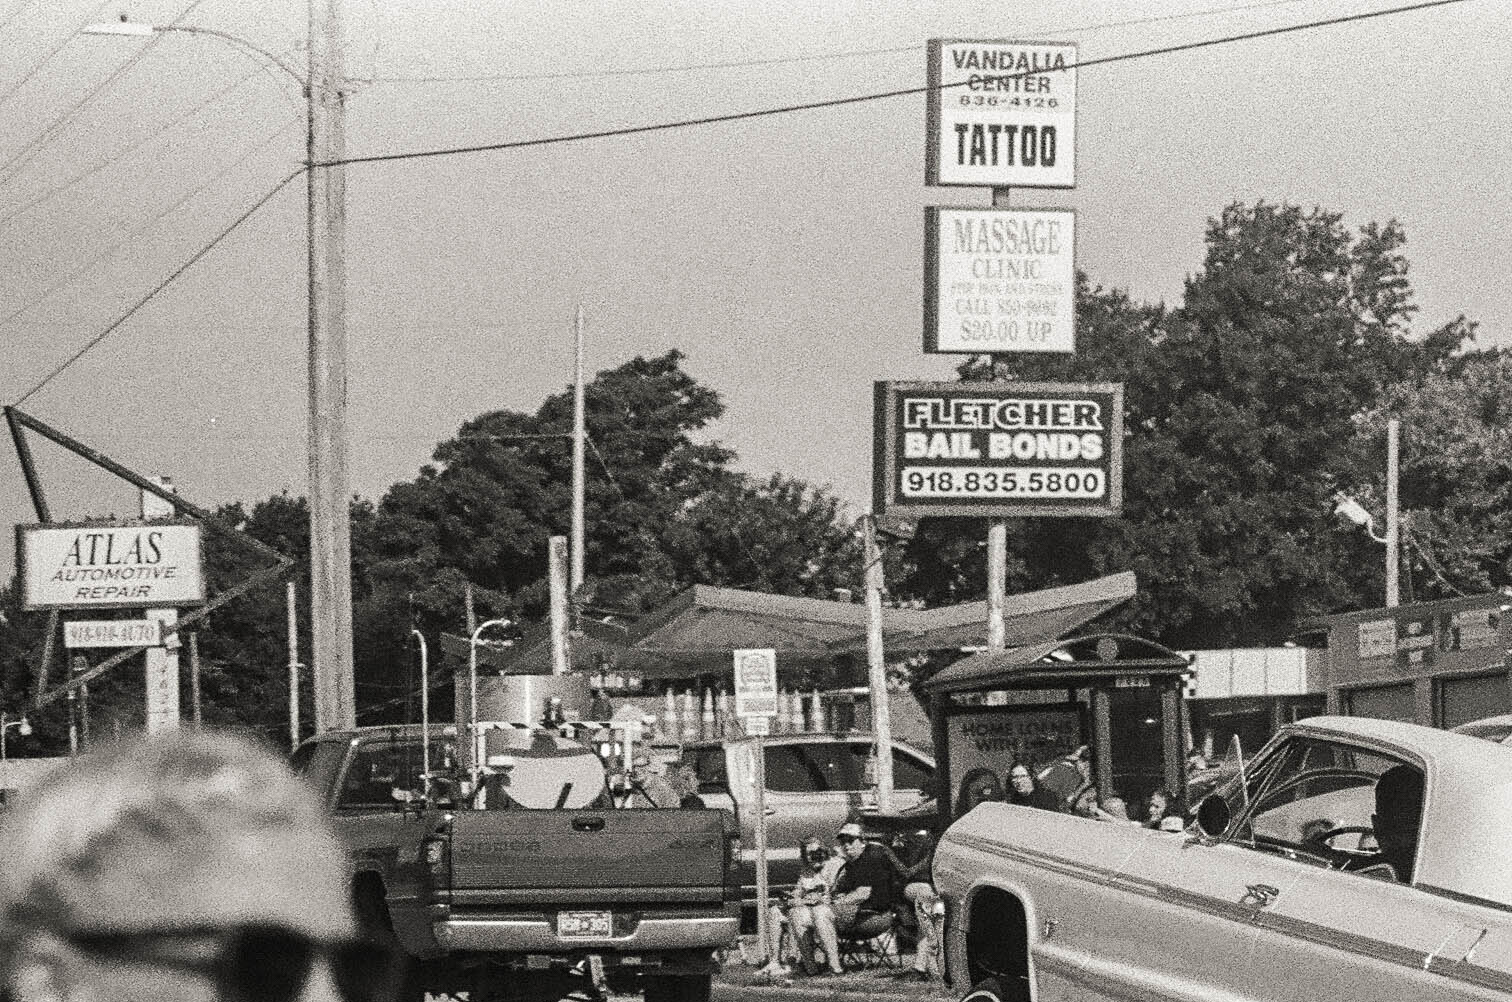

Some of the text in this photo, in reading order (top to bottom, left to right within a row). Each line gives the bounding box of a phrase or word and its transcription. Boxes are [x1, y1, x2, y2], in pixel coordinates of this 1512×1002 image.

[952, 49, 1066, 73] VANDALIA
[967, 74, 1051, 95] CENTER
[954, 123, 1057, 168] TATTOO
[952, 218, 1061, 255] MASSAGE
[972, 259, 1042, 280] CLINIC
[904, 398, 1104, 430] FLETCHER
[904, 432, 1104, 461] BAIL BONDS
[907, 471, 1099, 493] 918.835.5800
[62, 531, 163, 566] ATLAS
[50, 565, 178, 583] AUTOMOTIVE
[73, 585, 152, 600] REPAIR
